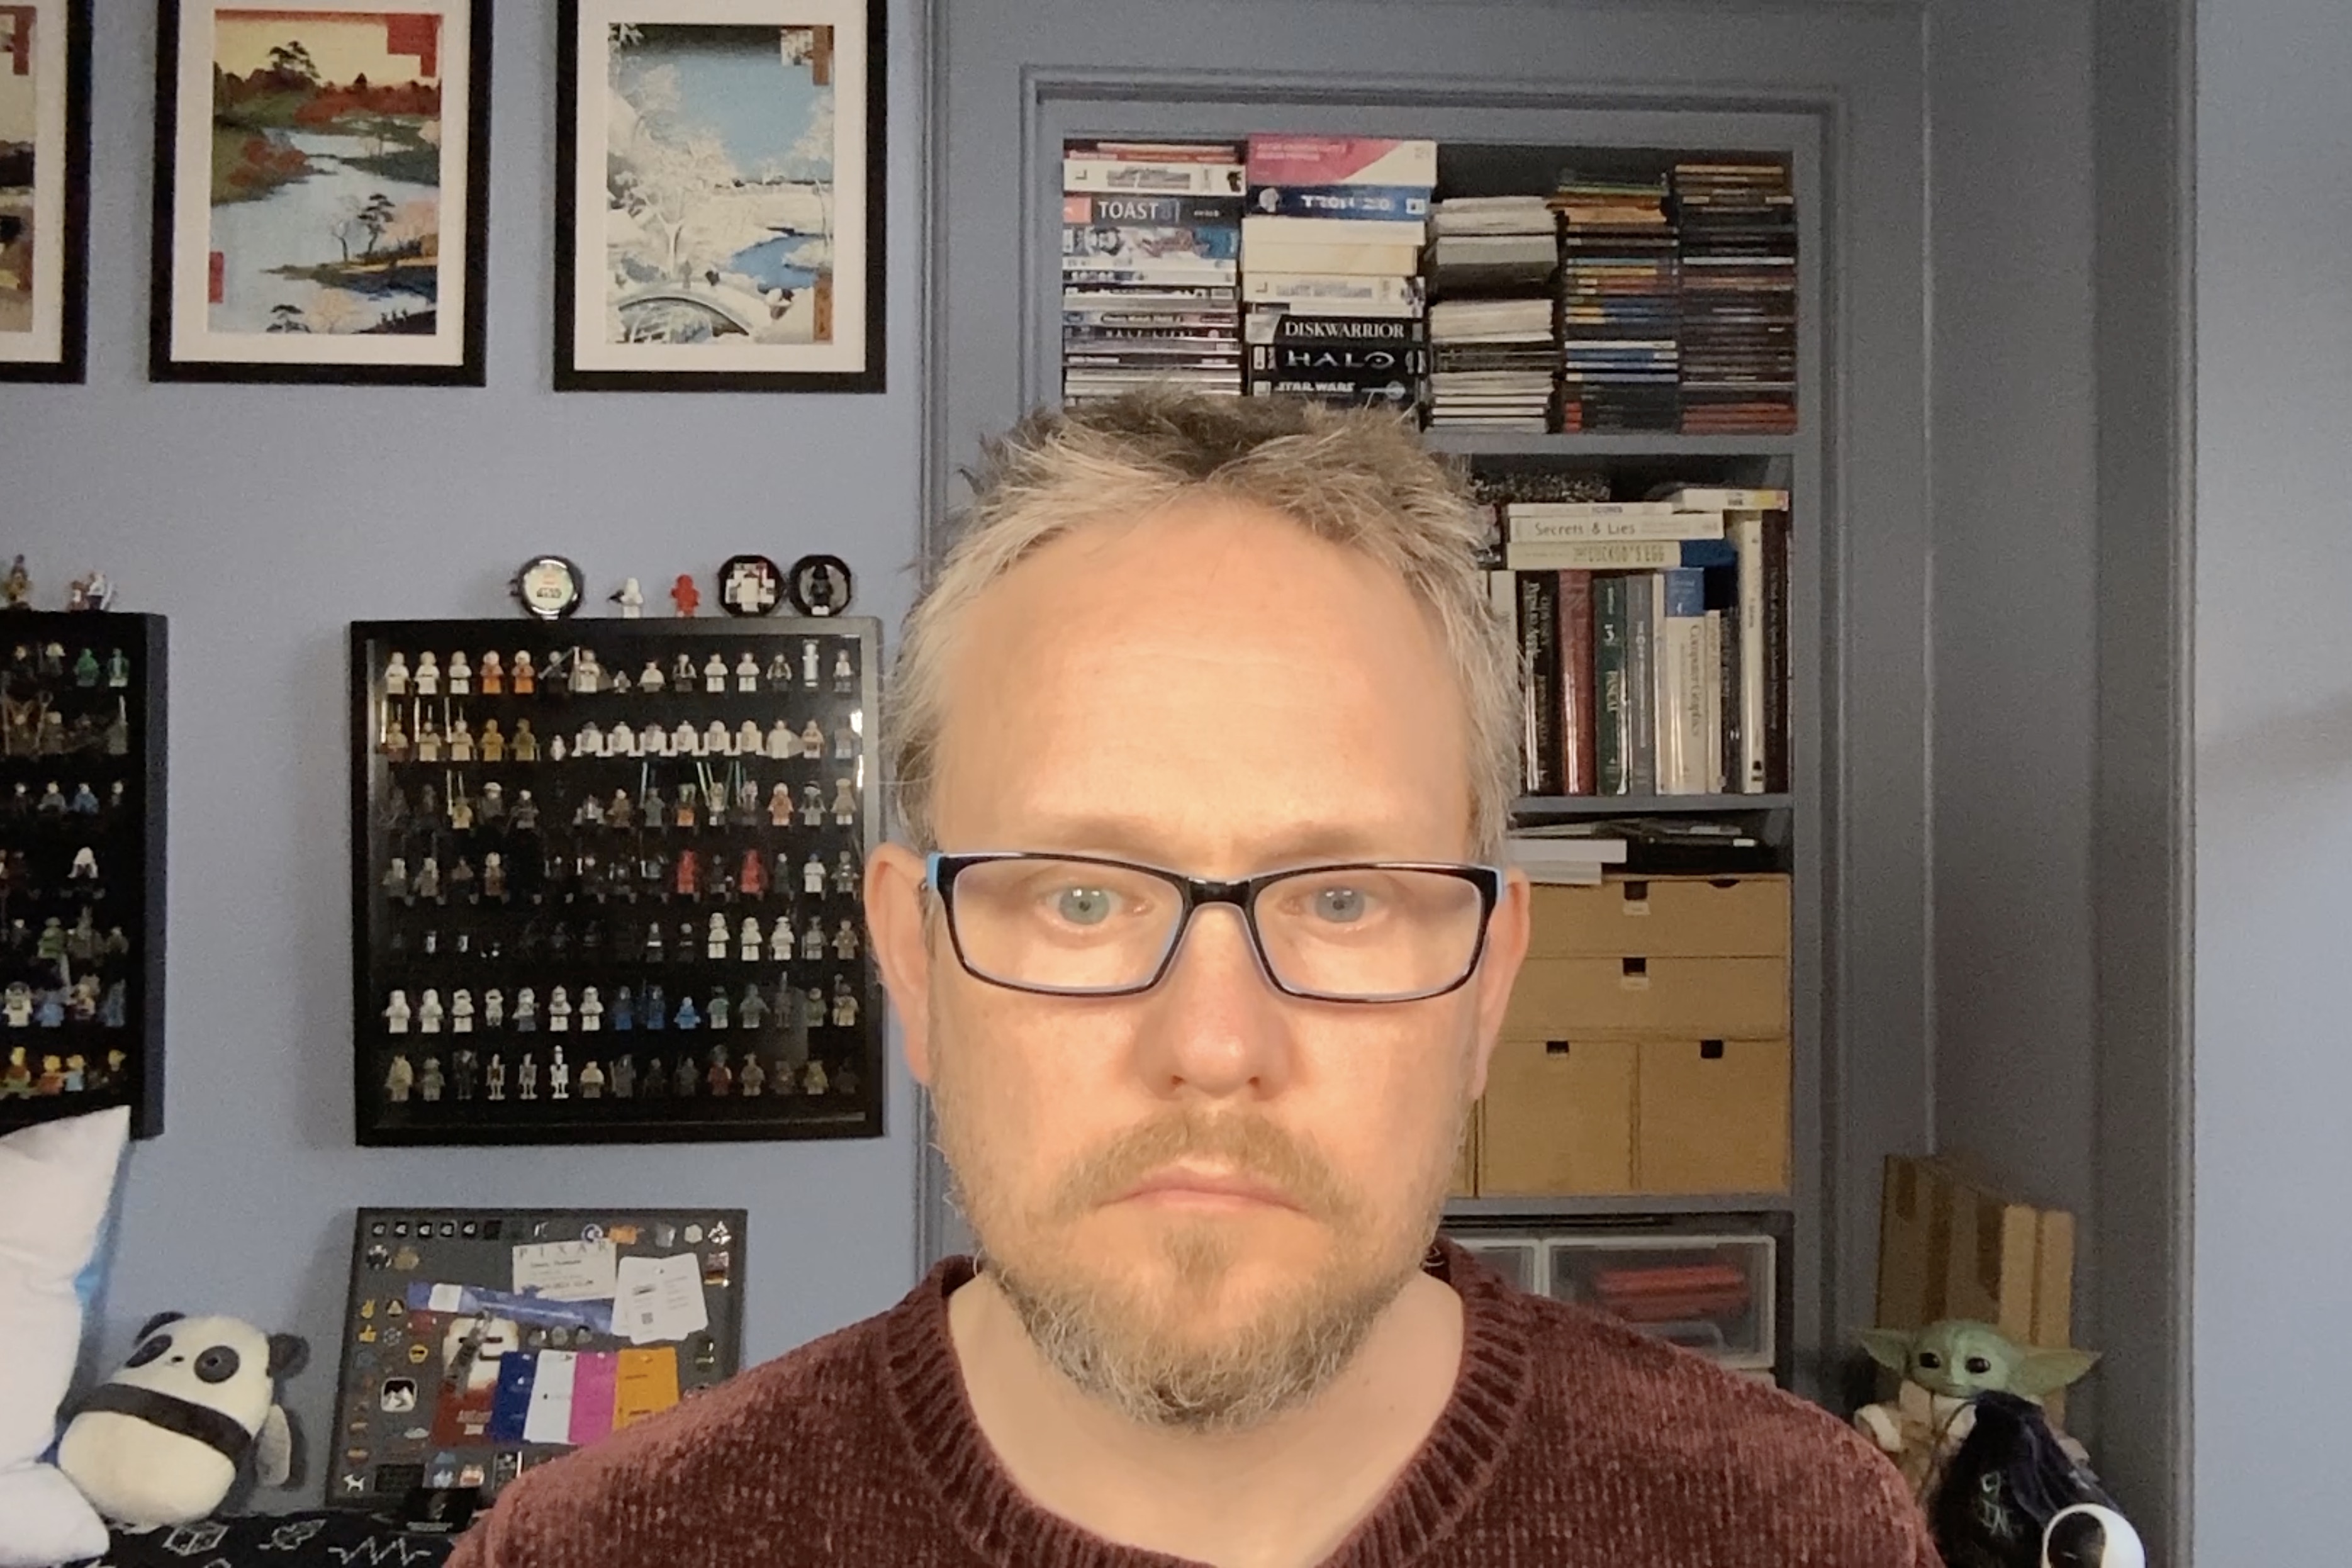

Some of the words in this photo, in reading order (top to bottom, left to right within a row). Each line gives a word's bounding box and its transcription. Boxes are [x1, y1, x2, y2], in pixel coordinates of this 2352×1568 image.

[1099, 201, 1159, 219] TOAST
[1285, 321, 1404, 339] DISKWARRIOR
[1285, 349, 1395, 369] HALO
[1275, 381, 1314, 392] STAR
[1315, 381, 1356, 393] WARS
[1535, 522, 1583, 535] Secrets
[1608, 523, 1635, 535] Lies
[518, 1241, 609, 1258] PIXAR
